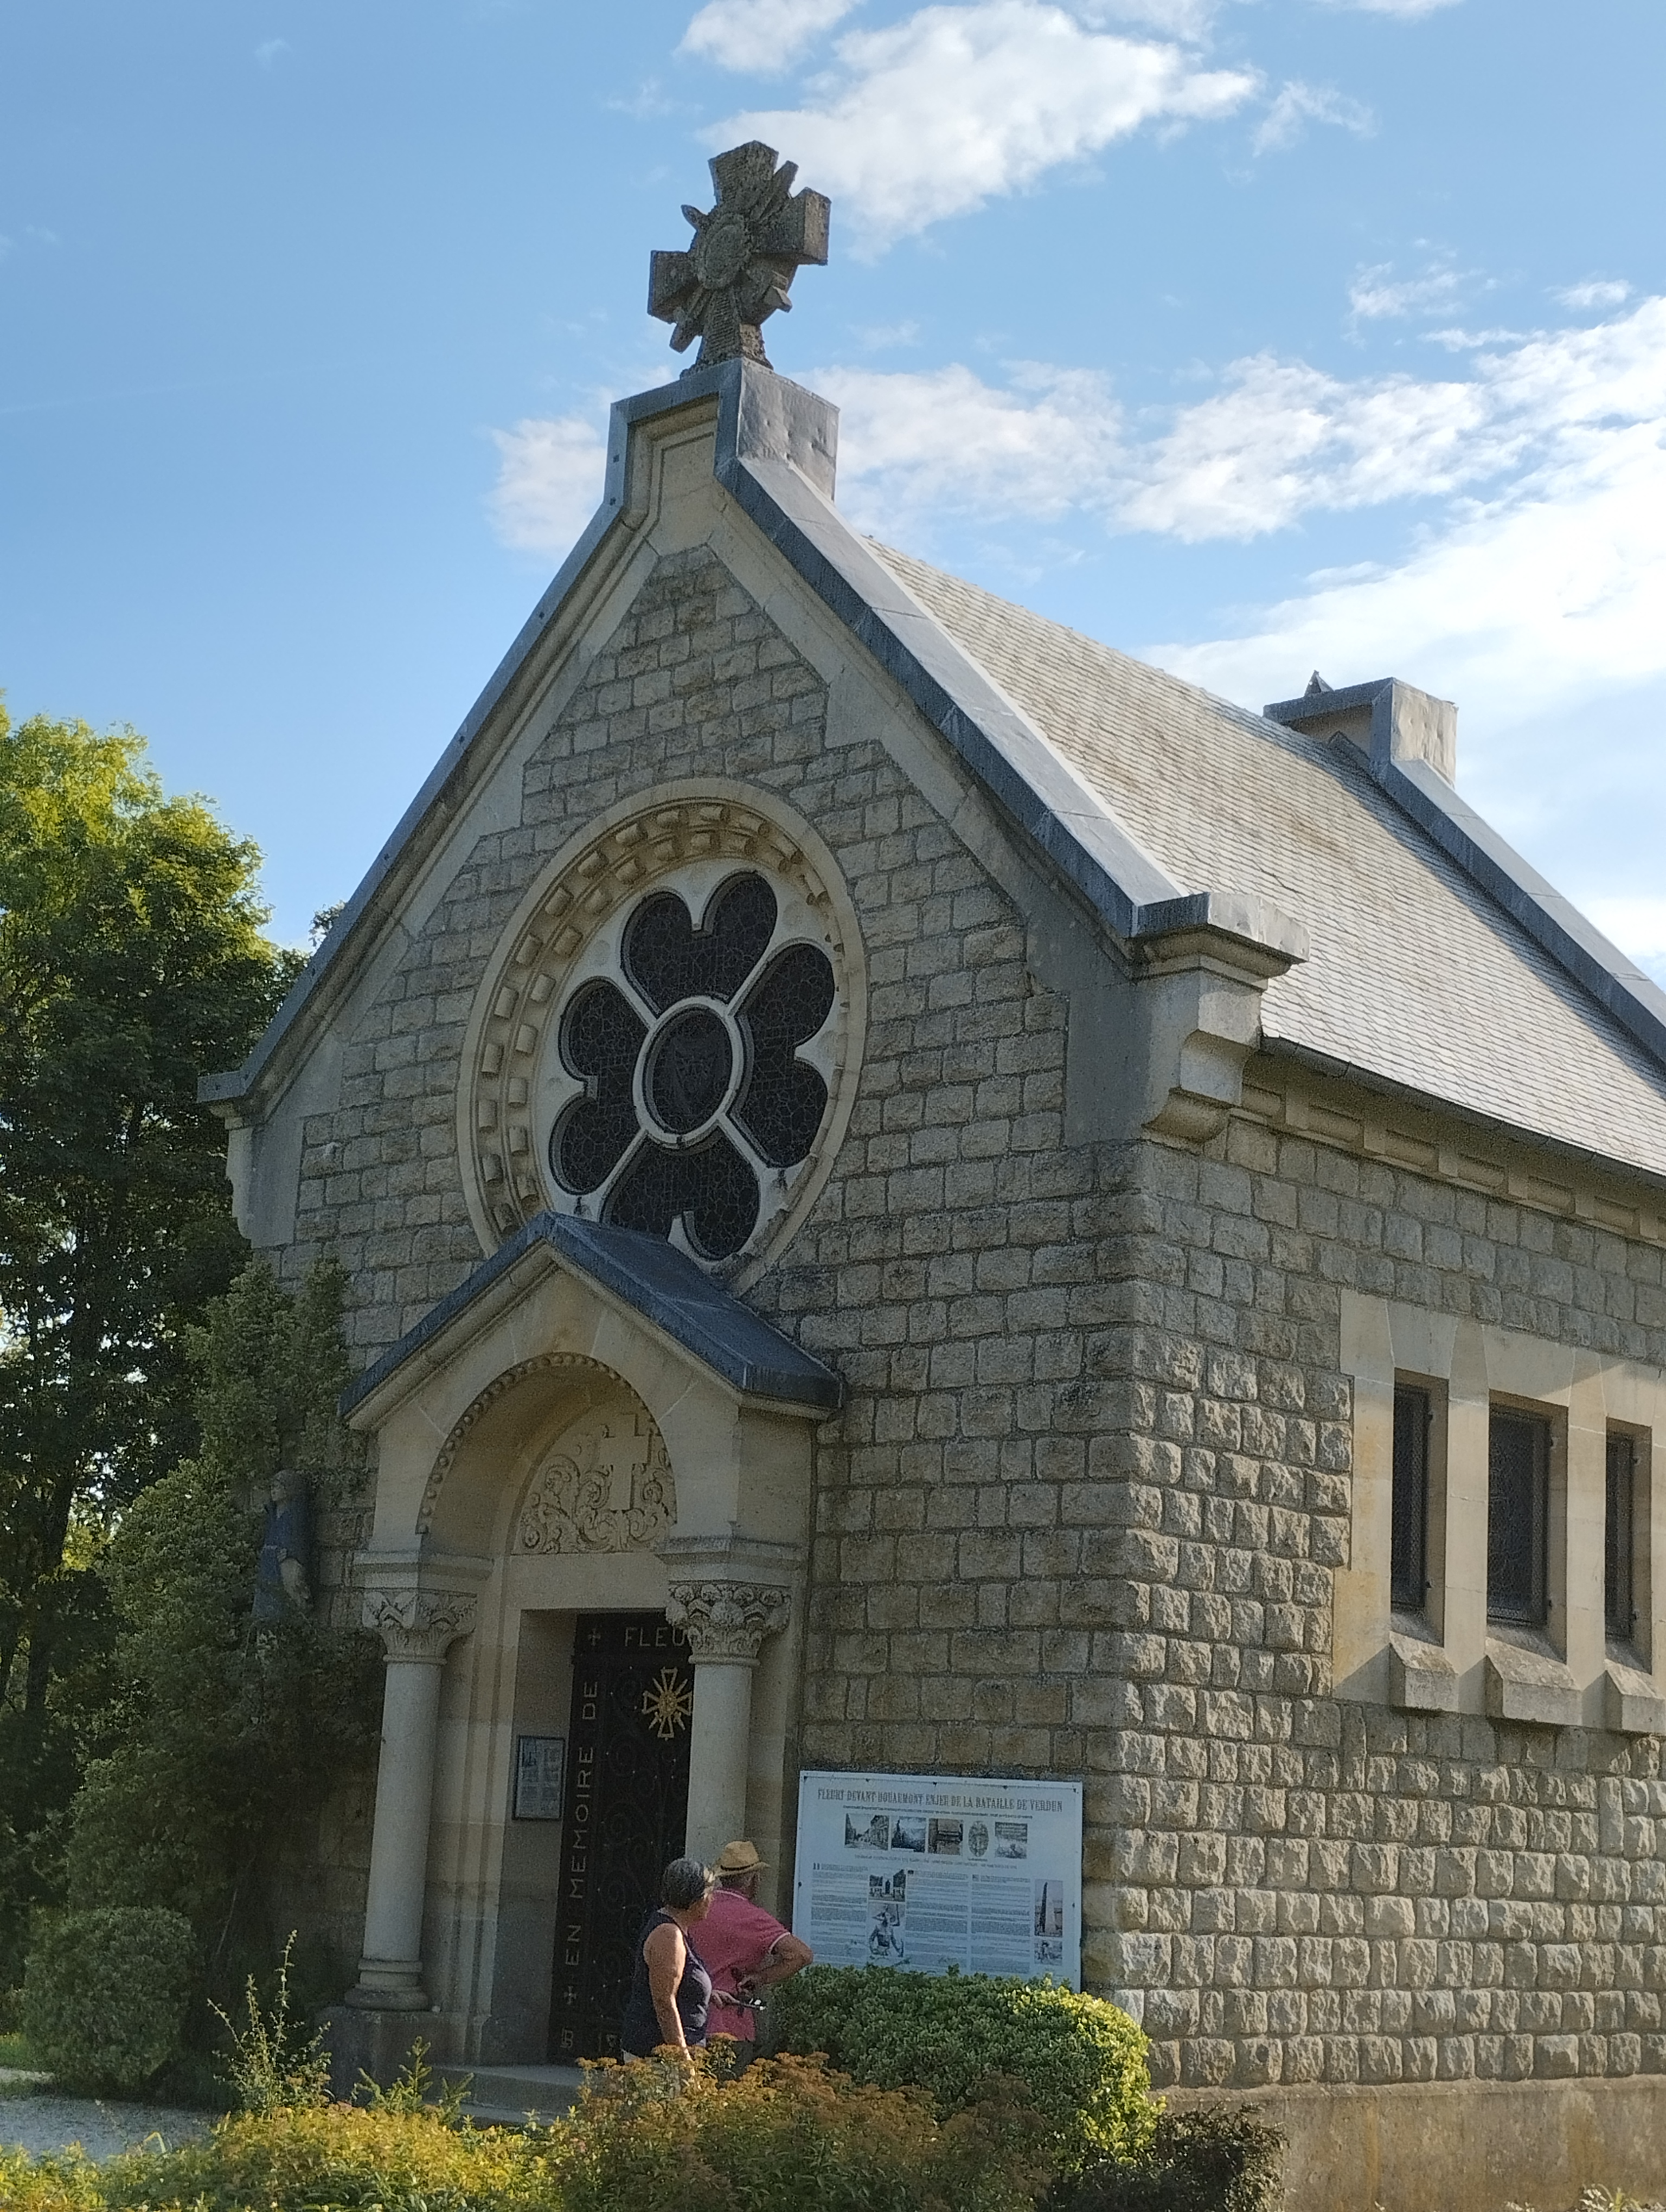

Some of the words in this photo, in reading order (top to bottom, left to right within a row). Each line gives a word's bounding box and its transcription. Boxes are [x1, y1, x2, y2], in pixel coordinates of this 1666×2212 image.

[625, 1626, 685, 1647] FLEU
[582, 1681, 597, 1720] DE
[847, 1790, 876, 1803] DEVANT
[877, 1791, 924, 1806] DOUAUMONT
[951, 1795, 962, 1807] DE
[963, 1796, 973, 1808] LA
[976, 1796, 1015, 1810] BATAILLE
[1016, 1798, 1027, 1811] DE
[1029, 1799, 1062, 1812] VERDUN
[569, 1746, 594, 1899] MEMOIRE
[565, 1925, 581, 1966] EN
